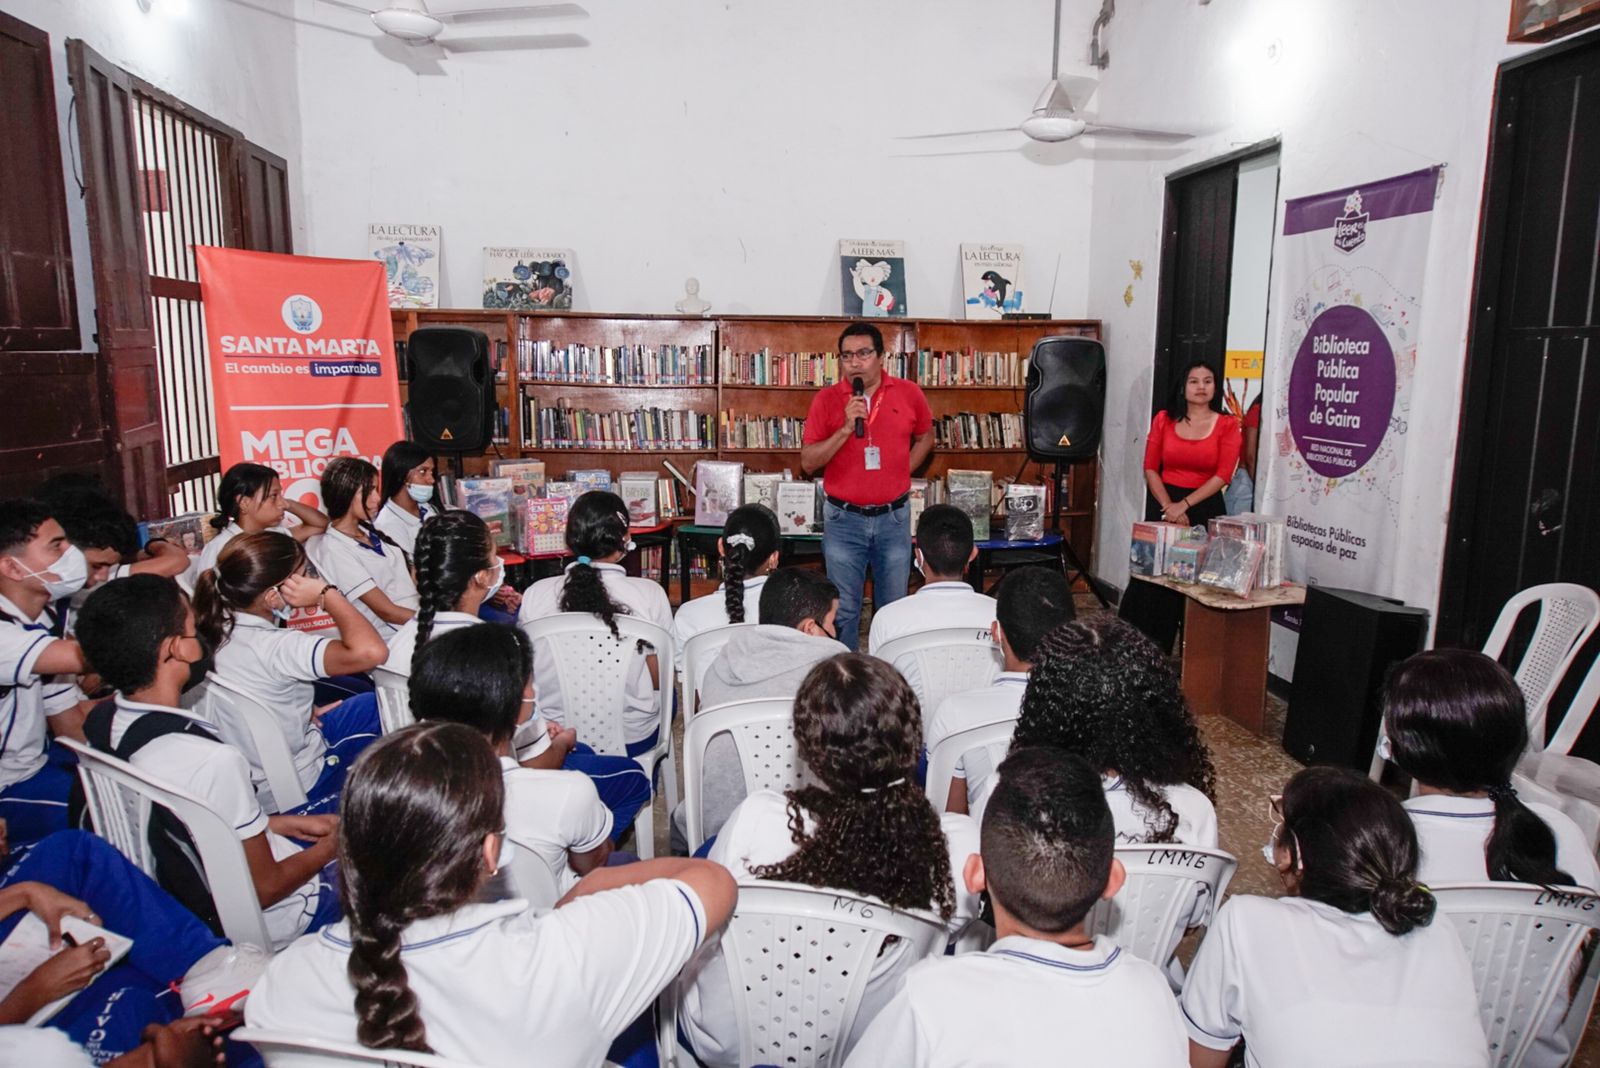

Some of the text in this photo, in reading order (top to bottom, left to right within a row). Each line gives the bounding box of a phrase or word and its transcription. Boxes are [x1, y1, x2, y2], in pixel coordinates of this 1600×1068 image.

[371, 224, 438, 237] LA LECTURA
[489, 250, 503, 258] HAY
[505, 251, 519, 259] QUE
[857, 248, 875, 256] LEER
[964, 251, 1021, 262] LA LECTURA
[220, 335, 382, 357] SANTA MARTA
[1313, 334, 1370, 355] Biblioteca
[224, 362, 378, 377] El cambio es imparable
[1317, 359, 1359, 379] Pública
[1315, 383, 1360, 406] Popular
[1309, 405, 1361, 429] de Gaira
[240, 427, 360, 462] MEGA
[1320, 444, 1344, 456] NACIONAL
[1344, 448, 1353, 457] DE
[1286, 515, 1367, 548] Bibliotecas Públicas
[1291, 532, 1358, 561] espacios de paz
[1147, 849, 1208, 870] LMM6
